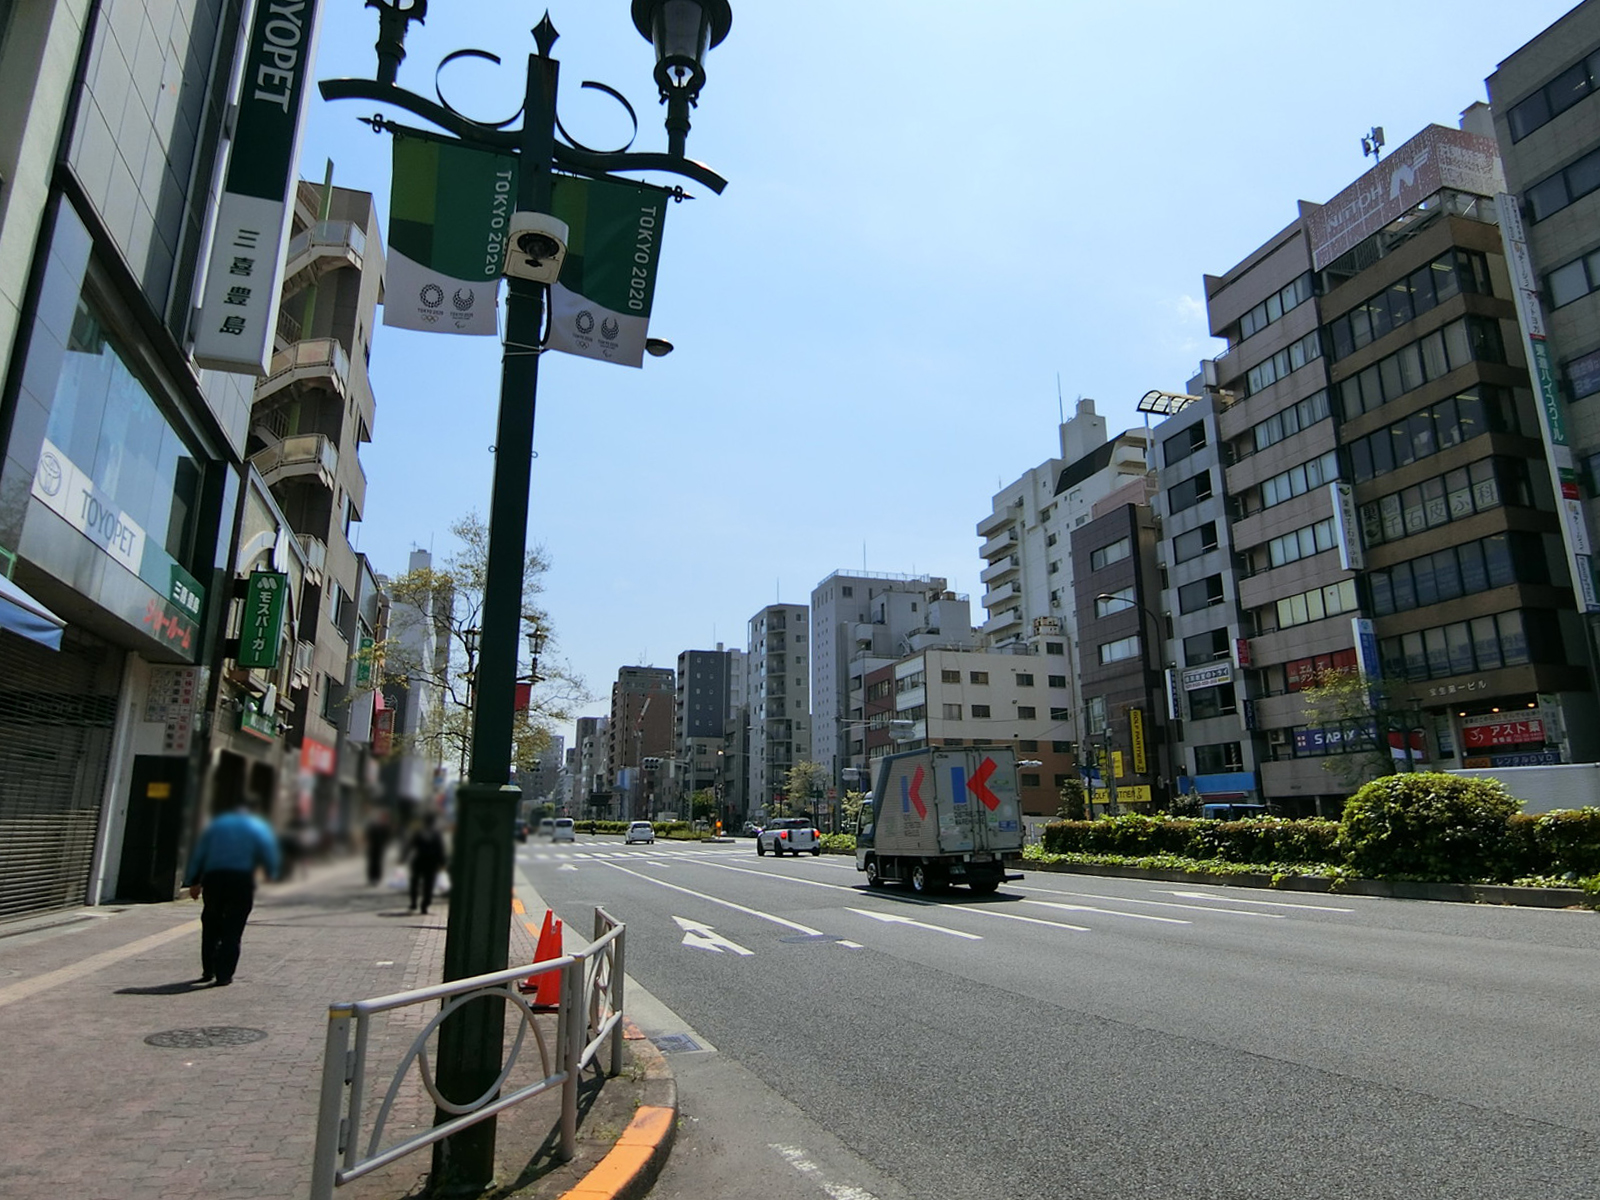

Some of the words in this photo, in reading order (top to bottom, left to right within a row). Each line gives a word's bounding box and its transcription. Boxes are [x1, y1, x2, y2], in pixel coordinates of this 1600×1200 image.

[254, 0, 307, 114] YOPET
[490, 170, 512, 229] TOKYO
[1325, 184, 1383, 234] NITTOH
[484, 233, 503, 275] 2020
[633, 205, 657, 265] TOKYO
[627, 270, 648, 310] 2020
[80, 488, 137, 558] TOYOPET
[251, 591, 273, 662] モスバーガー
[1314, 729, 1355, 745] SAPIX
[1496, 753, 1553, 765] レンタルDVD
